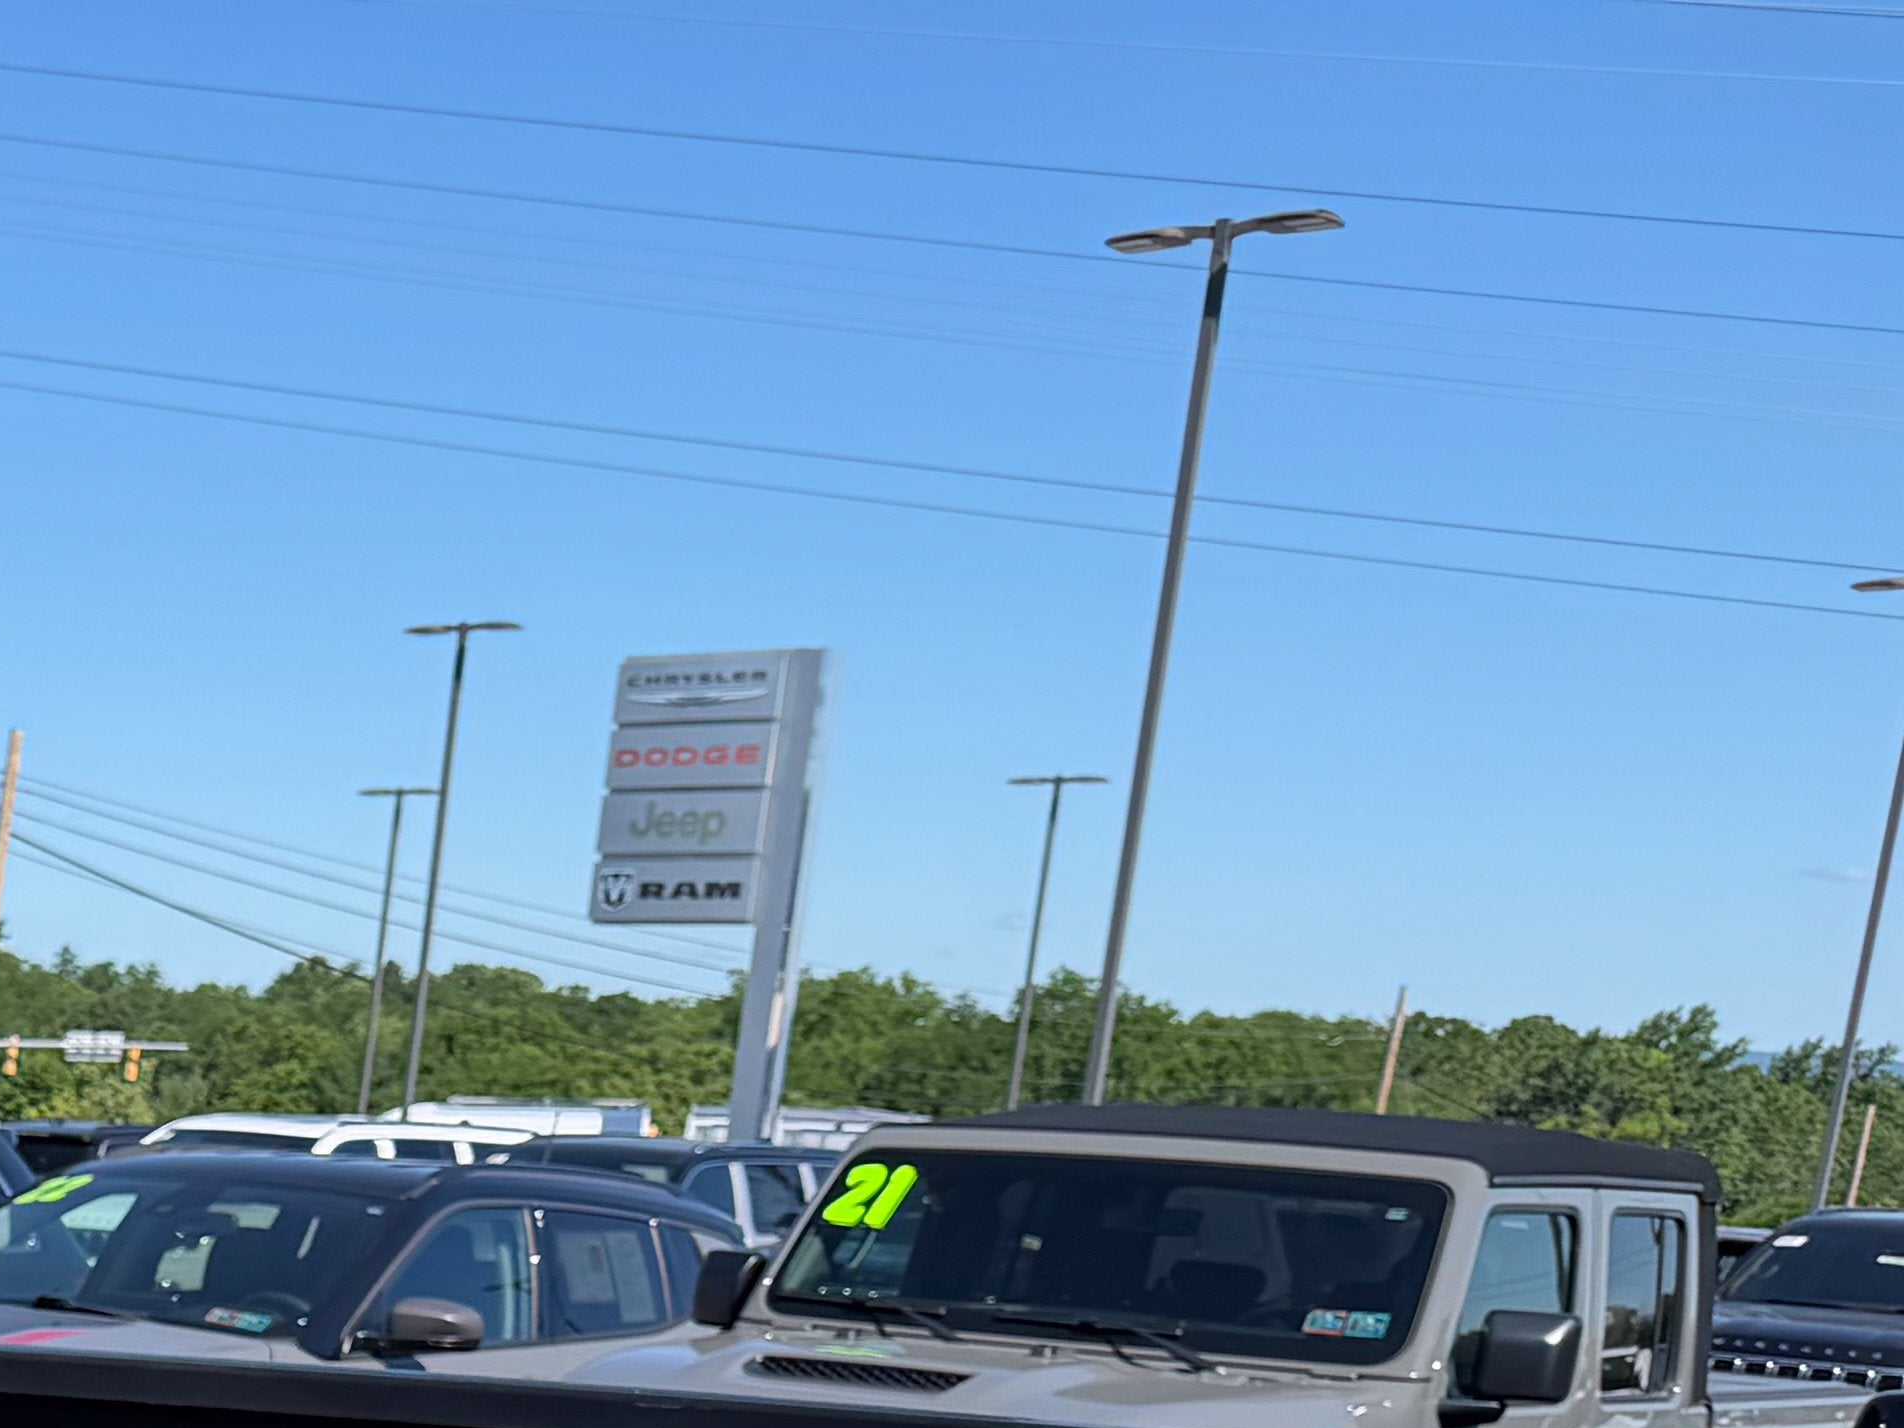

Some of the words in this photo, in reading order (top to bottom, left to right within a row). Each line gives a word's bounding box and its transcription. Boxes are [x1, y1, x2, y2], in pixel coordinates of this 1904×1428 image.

[626, 671, 768, 688] CHRYSLER
[612, 744, 762, 768] DODGE
[629, 802, 725, 845] Jeep
[640, 882, 741, 899] RAM
[822, 1163, 919, 1230] 21
